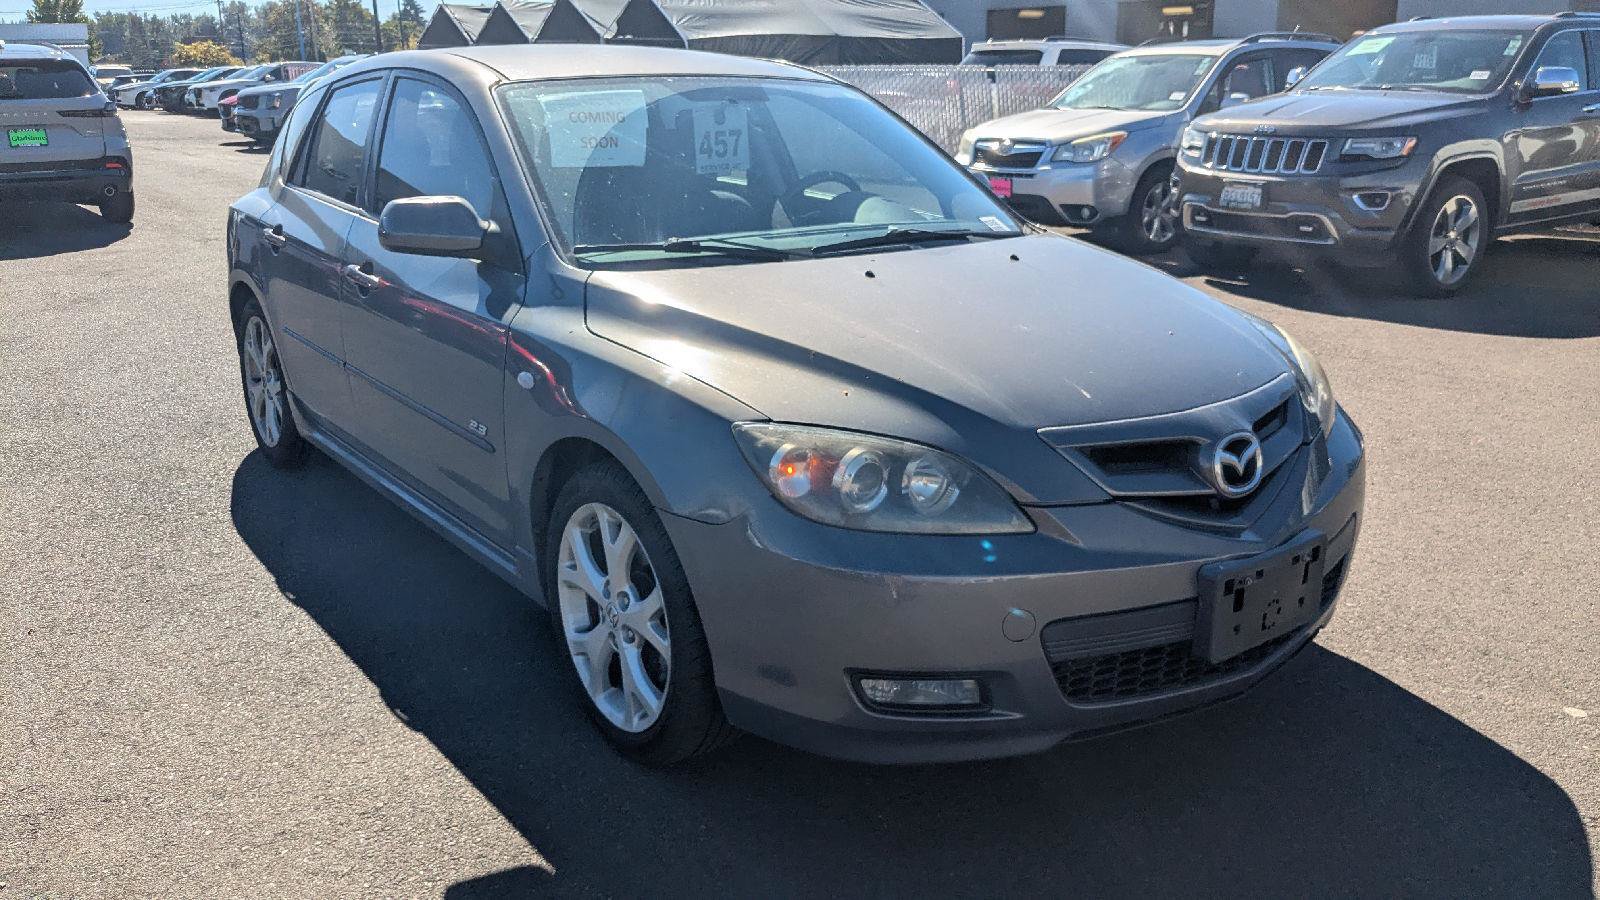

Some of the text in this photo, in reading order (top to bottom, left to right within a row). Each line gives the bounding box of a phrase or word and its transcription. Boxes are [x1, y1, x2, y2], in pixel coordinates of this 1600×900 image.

[569, 111, 626, 124] COMING
[581, 136, 619, 149] SOON
[700, 129, 743, 158] 457
